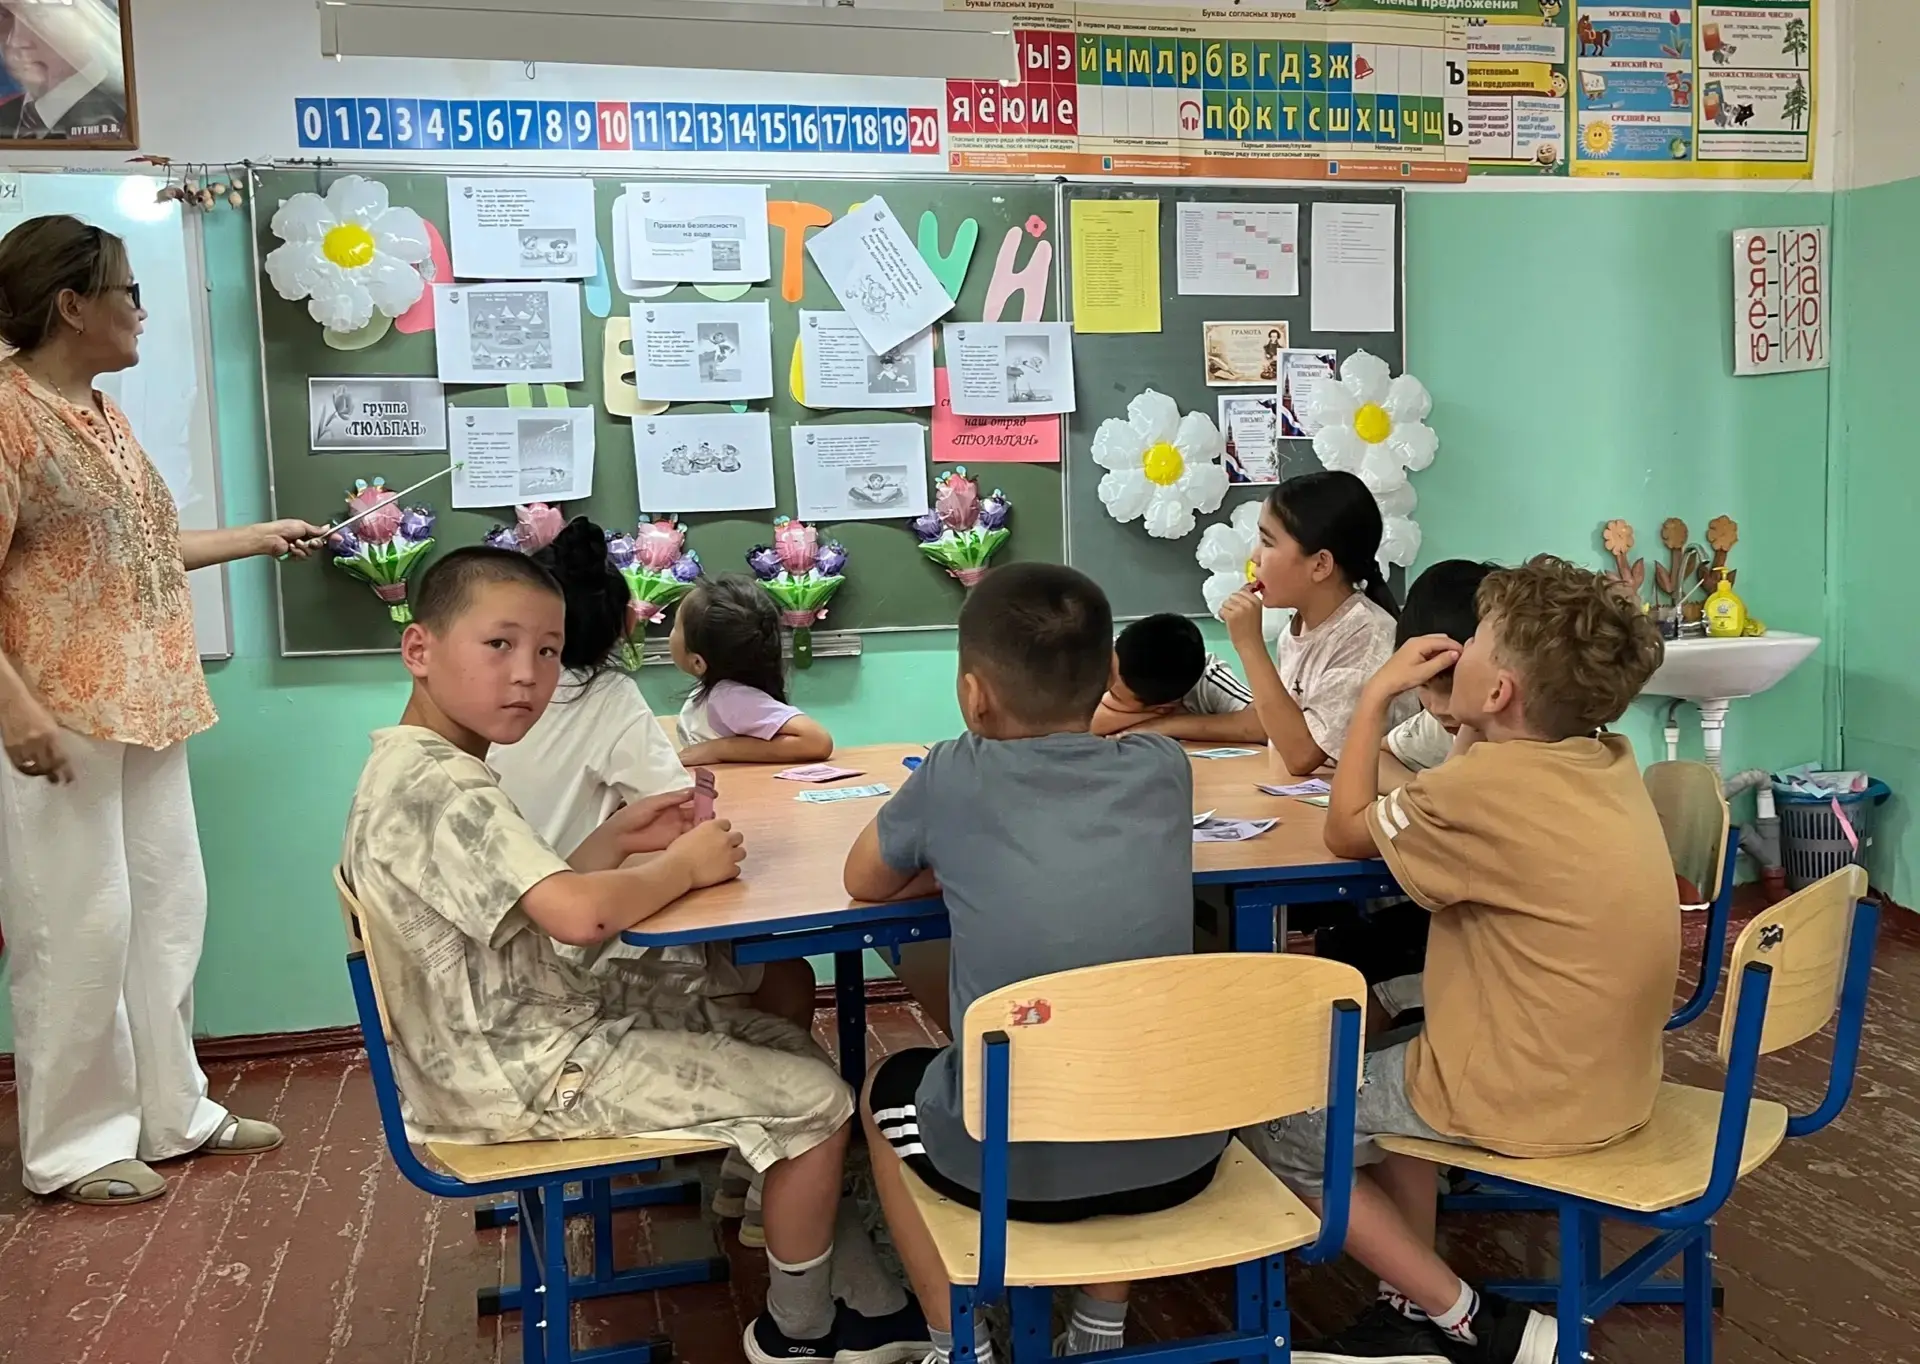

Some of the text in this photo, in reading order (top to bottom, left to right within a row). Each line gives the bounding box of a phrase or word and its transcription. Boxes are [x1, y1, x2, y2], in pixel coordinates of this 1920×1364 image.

[965, 0, 991, 9] Буквы
[1028, 2, 1054, 10] звуков
[1202, 9, 1297, 19] Буквы согласных звуков
[1081, 37, 1097, 72] й
[1105, 48, 1122, 73] н
[1128, 49, 1150, 74] м
[1156, 50, 1177, 74] л
[1181, 50, 1198, 84] р
[1206, 43, 1223, 77] б
[1231, 53, 1248, 77] в
[1258, 53, 1271, 77] г
[1280, 53, 1300, 84] д
[1308, 54, 1322, 79] з
[1328, 54, 1349, 79] ж
[952, 97, 970, 122] я
[978, 88, 996, 123] ё
[1001, 98, 1025, 123] ю
[1031, 99, 1049, 123] и
[1057, 99, 1074, 125] е
[1206, 105, 1223, 130] п
[1229, 97, 1250, 139] ф
[1256, 106, 1271, 130] к
[1283, 106, 1297, 130] т
[1308, 107, 1321, 132] с
[1328, 107, 1350, 132] ш
[1356, 108, 1371, 132] х
[1379, 108, 1396, 139] ц
[1403, 110, 1418, 134] ч
[1423, 110, 1443, 140] щ
[71, 125, 99, 136] ПУТИН
[303, 106, 937, 147] 0 1 2 3 4 5 6 7 8 9 10 11 12 13 14 15 16 17 18 19 20
[653, 221, 738, 229] Правила безопасности
[363, 402, 408, 416] группа
[345, 421, 427, 436] «ТЮЛЬПАН»
[964, 416, 1027, 429] наш отряд
[952, 434, 1038, 446] «ТЮЛЬПАН»
